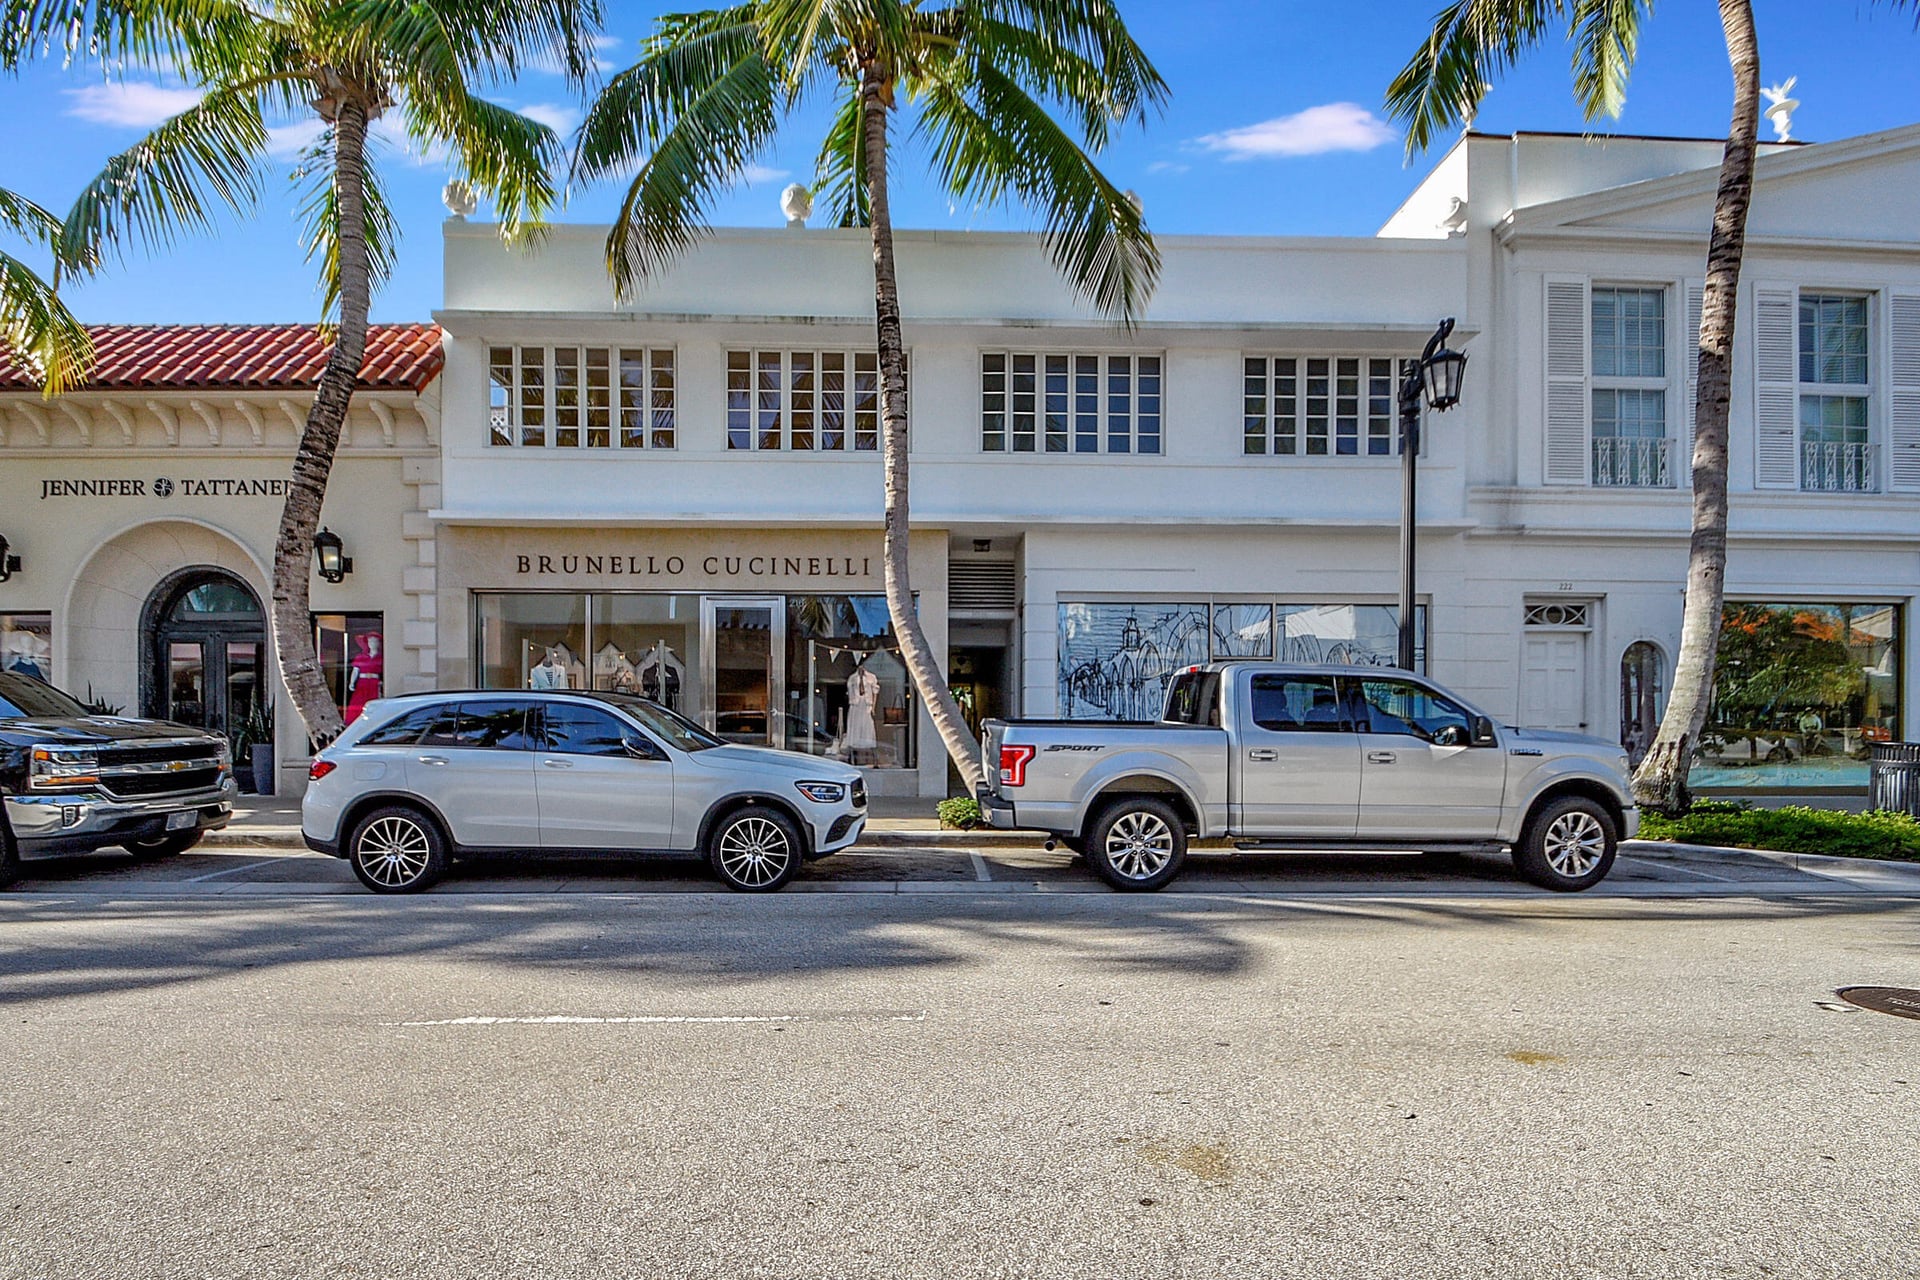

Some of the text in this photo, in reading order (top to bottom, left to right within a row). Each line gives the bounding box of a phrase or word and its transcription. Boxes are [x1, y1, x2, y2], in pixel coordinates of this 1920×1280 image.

[41, 479, 146, 499] JENNIFER
[516, 555, 871, 576] BRUNELLO CUCINELLI
[1043, 744, 1105, 752] SPORT
